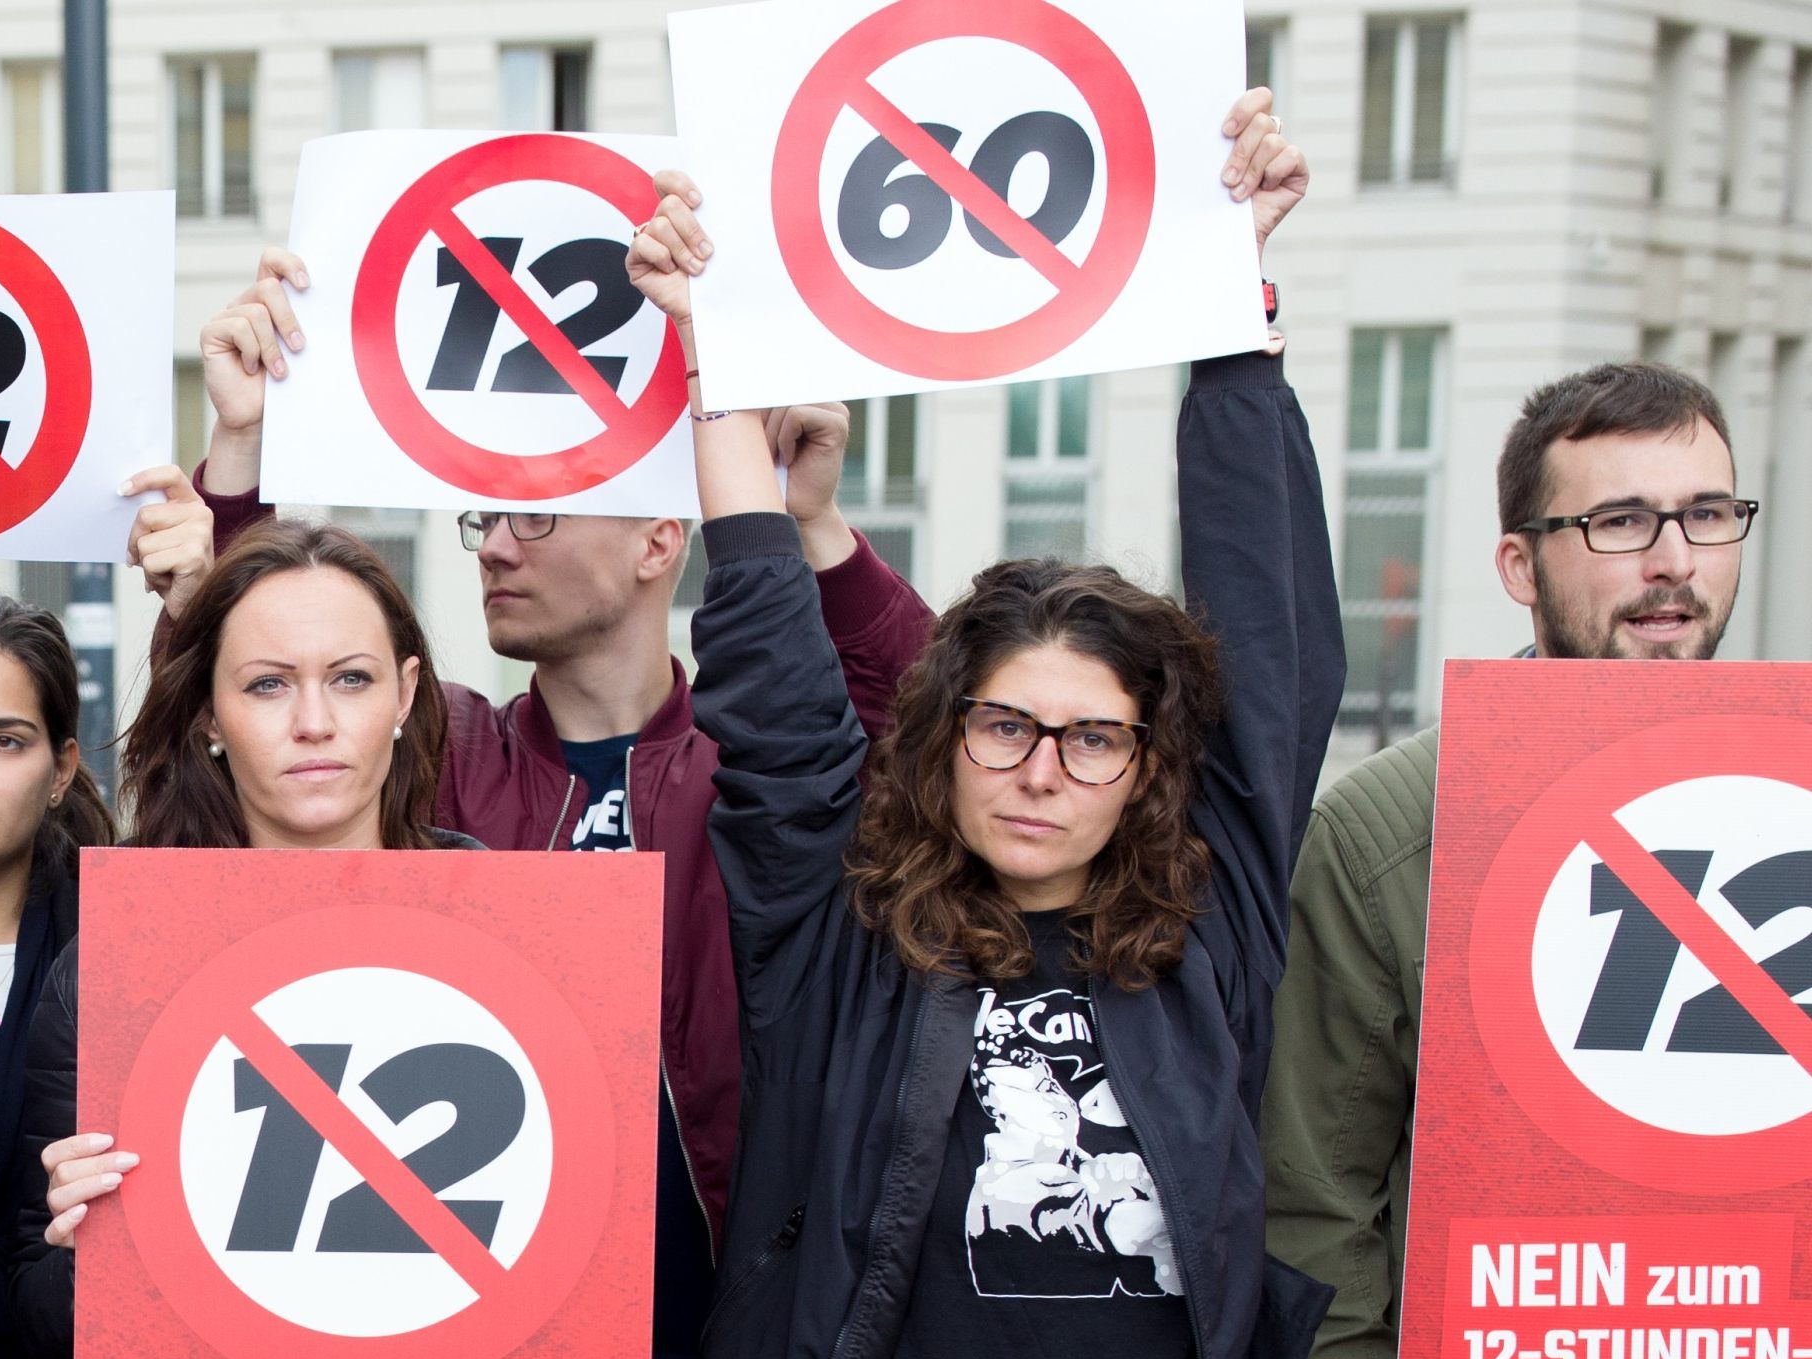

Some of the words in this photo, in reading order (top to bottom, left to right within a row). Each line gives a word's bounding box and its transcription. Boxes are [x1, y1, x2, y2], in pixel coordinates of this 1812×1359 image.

[837, 111, 1095, 257] 60
[425, 236, 646, 394] 12
[1574, 850, 1812, 1055] 12
[225, 1042, 526, 1254] 12
[1471, 1242, 1626, 1308] NEIN
[1646, 1265, 1761, 1306] zum
